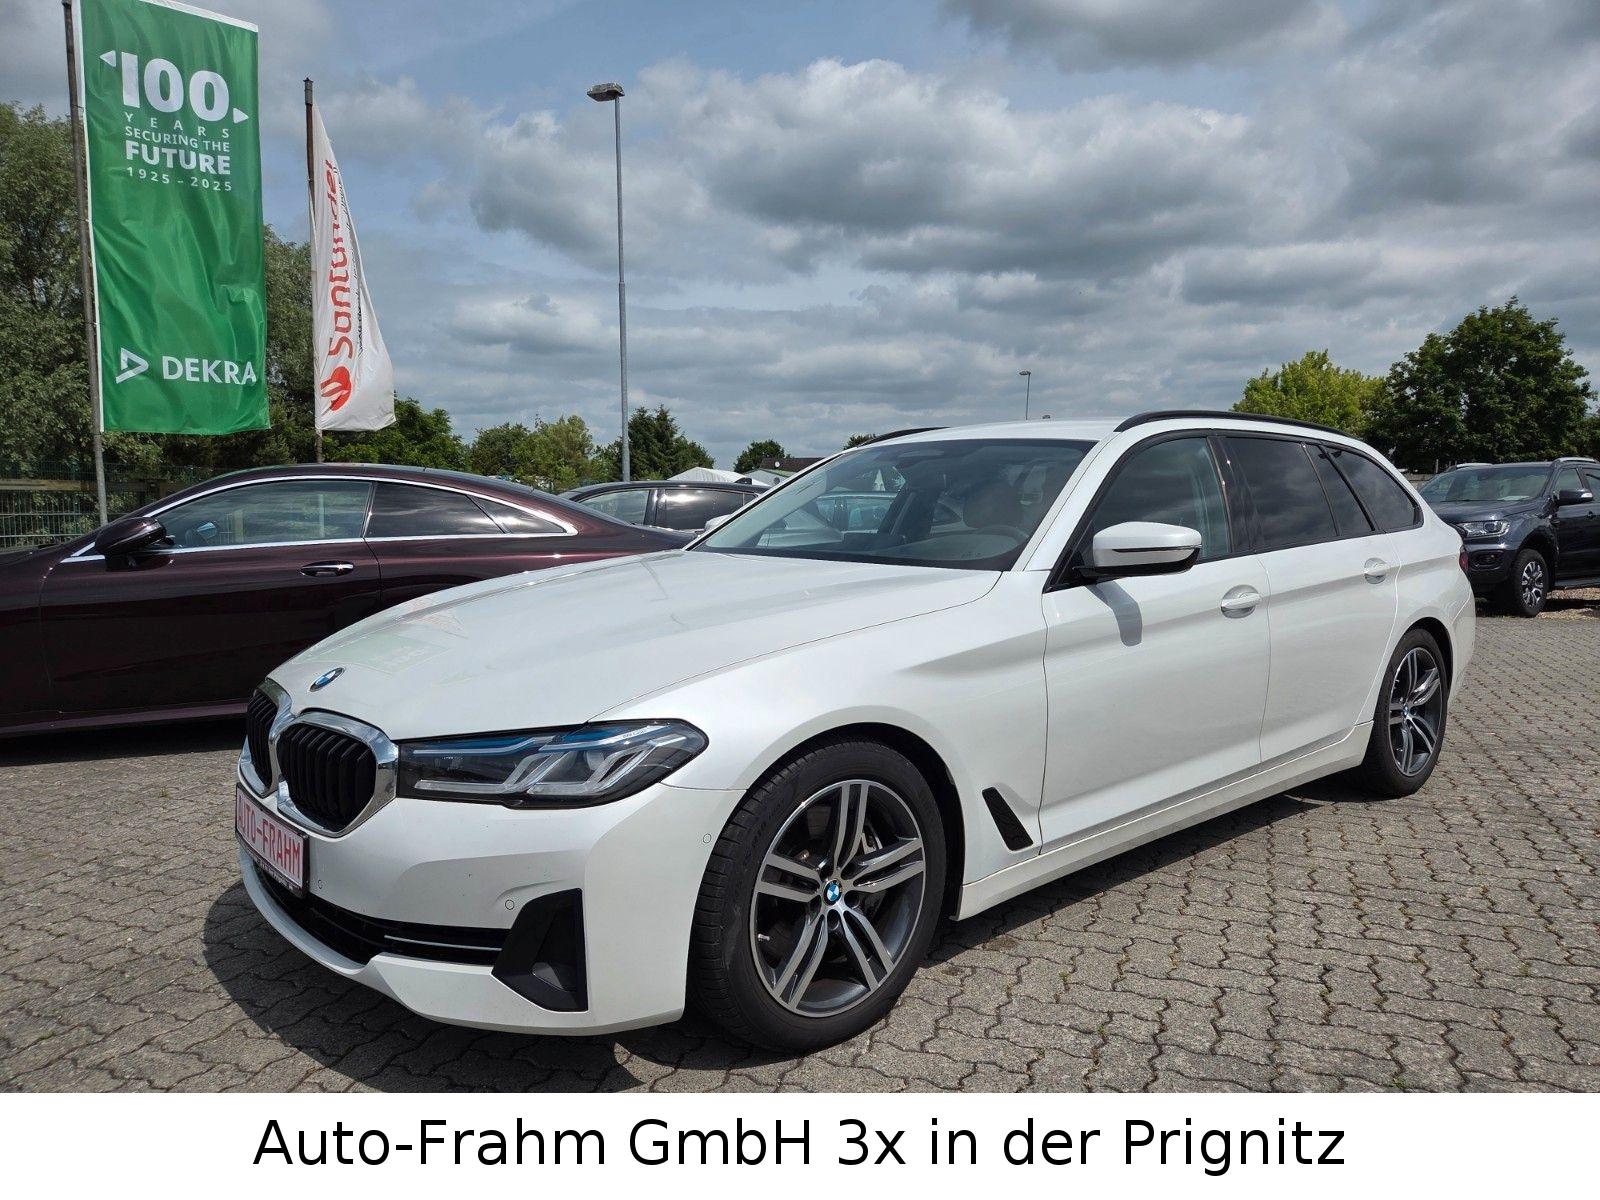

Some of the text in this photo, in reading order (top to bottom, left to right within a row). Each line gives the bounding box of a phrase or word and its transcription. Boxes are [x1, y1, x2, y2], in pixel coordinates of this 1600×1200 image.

[121, 51, 230, 122] 100
[124, 111, 230, 139] YEARS
[125, 126, 230, 153] SECURING THE
[125, 139, 231, 175] FUTURE
[126, 166, 170, 184] 1925
[190, 176, 232, 192] 2025
[162, 355, 257, 385] DEKRA
[238, 795, 301, 880] AUTO-FRAHM
